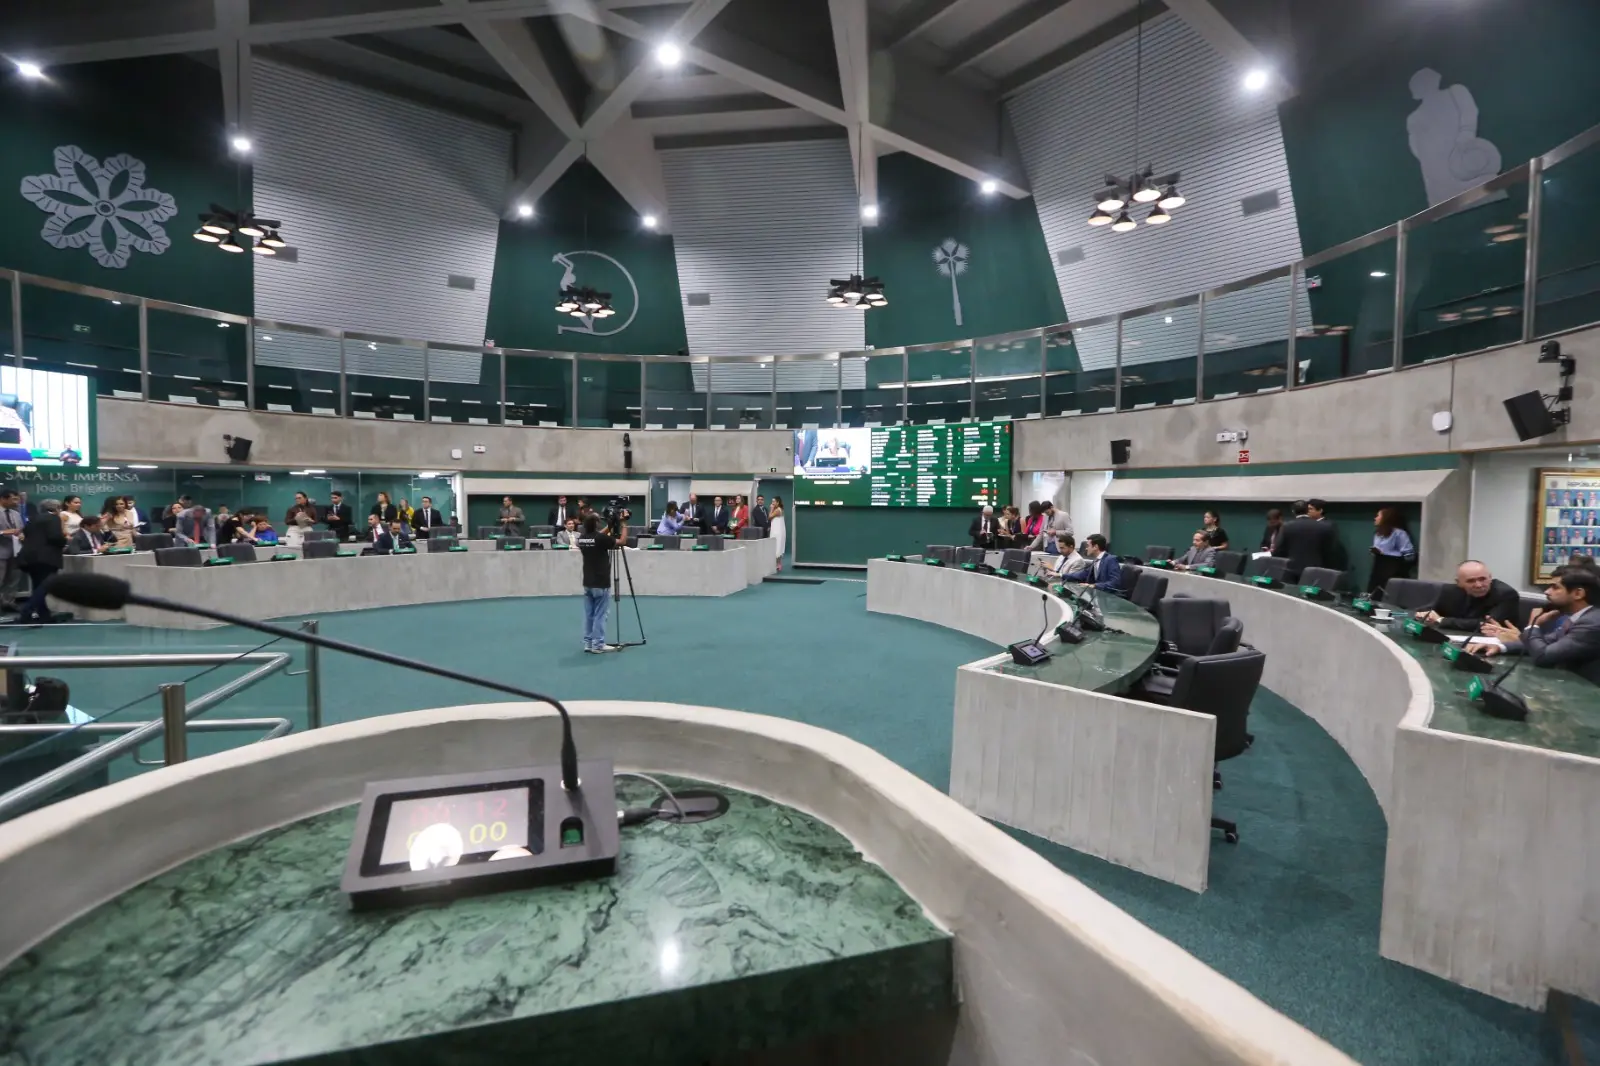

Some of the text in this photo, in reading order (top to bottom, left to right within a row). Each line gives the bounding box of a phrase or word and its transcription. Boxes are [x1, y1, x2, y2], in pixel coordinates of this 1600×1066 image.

[5, 471, 140, 482] SALA DE IMPRENSA
